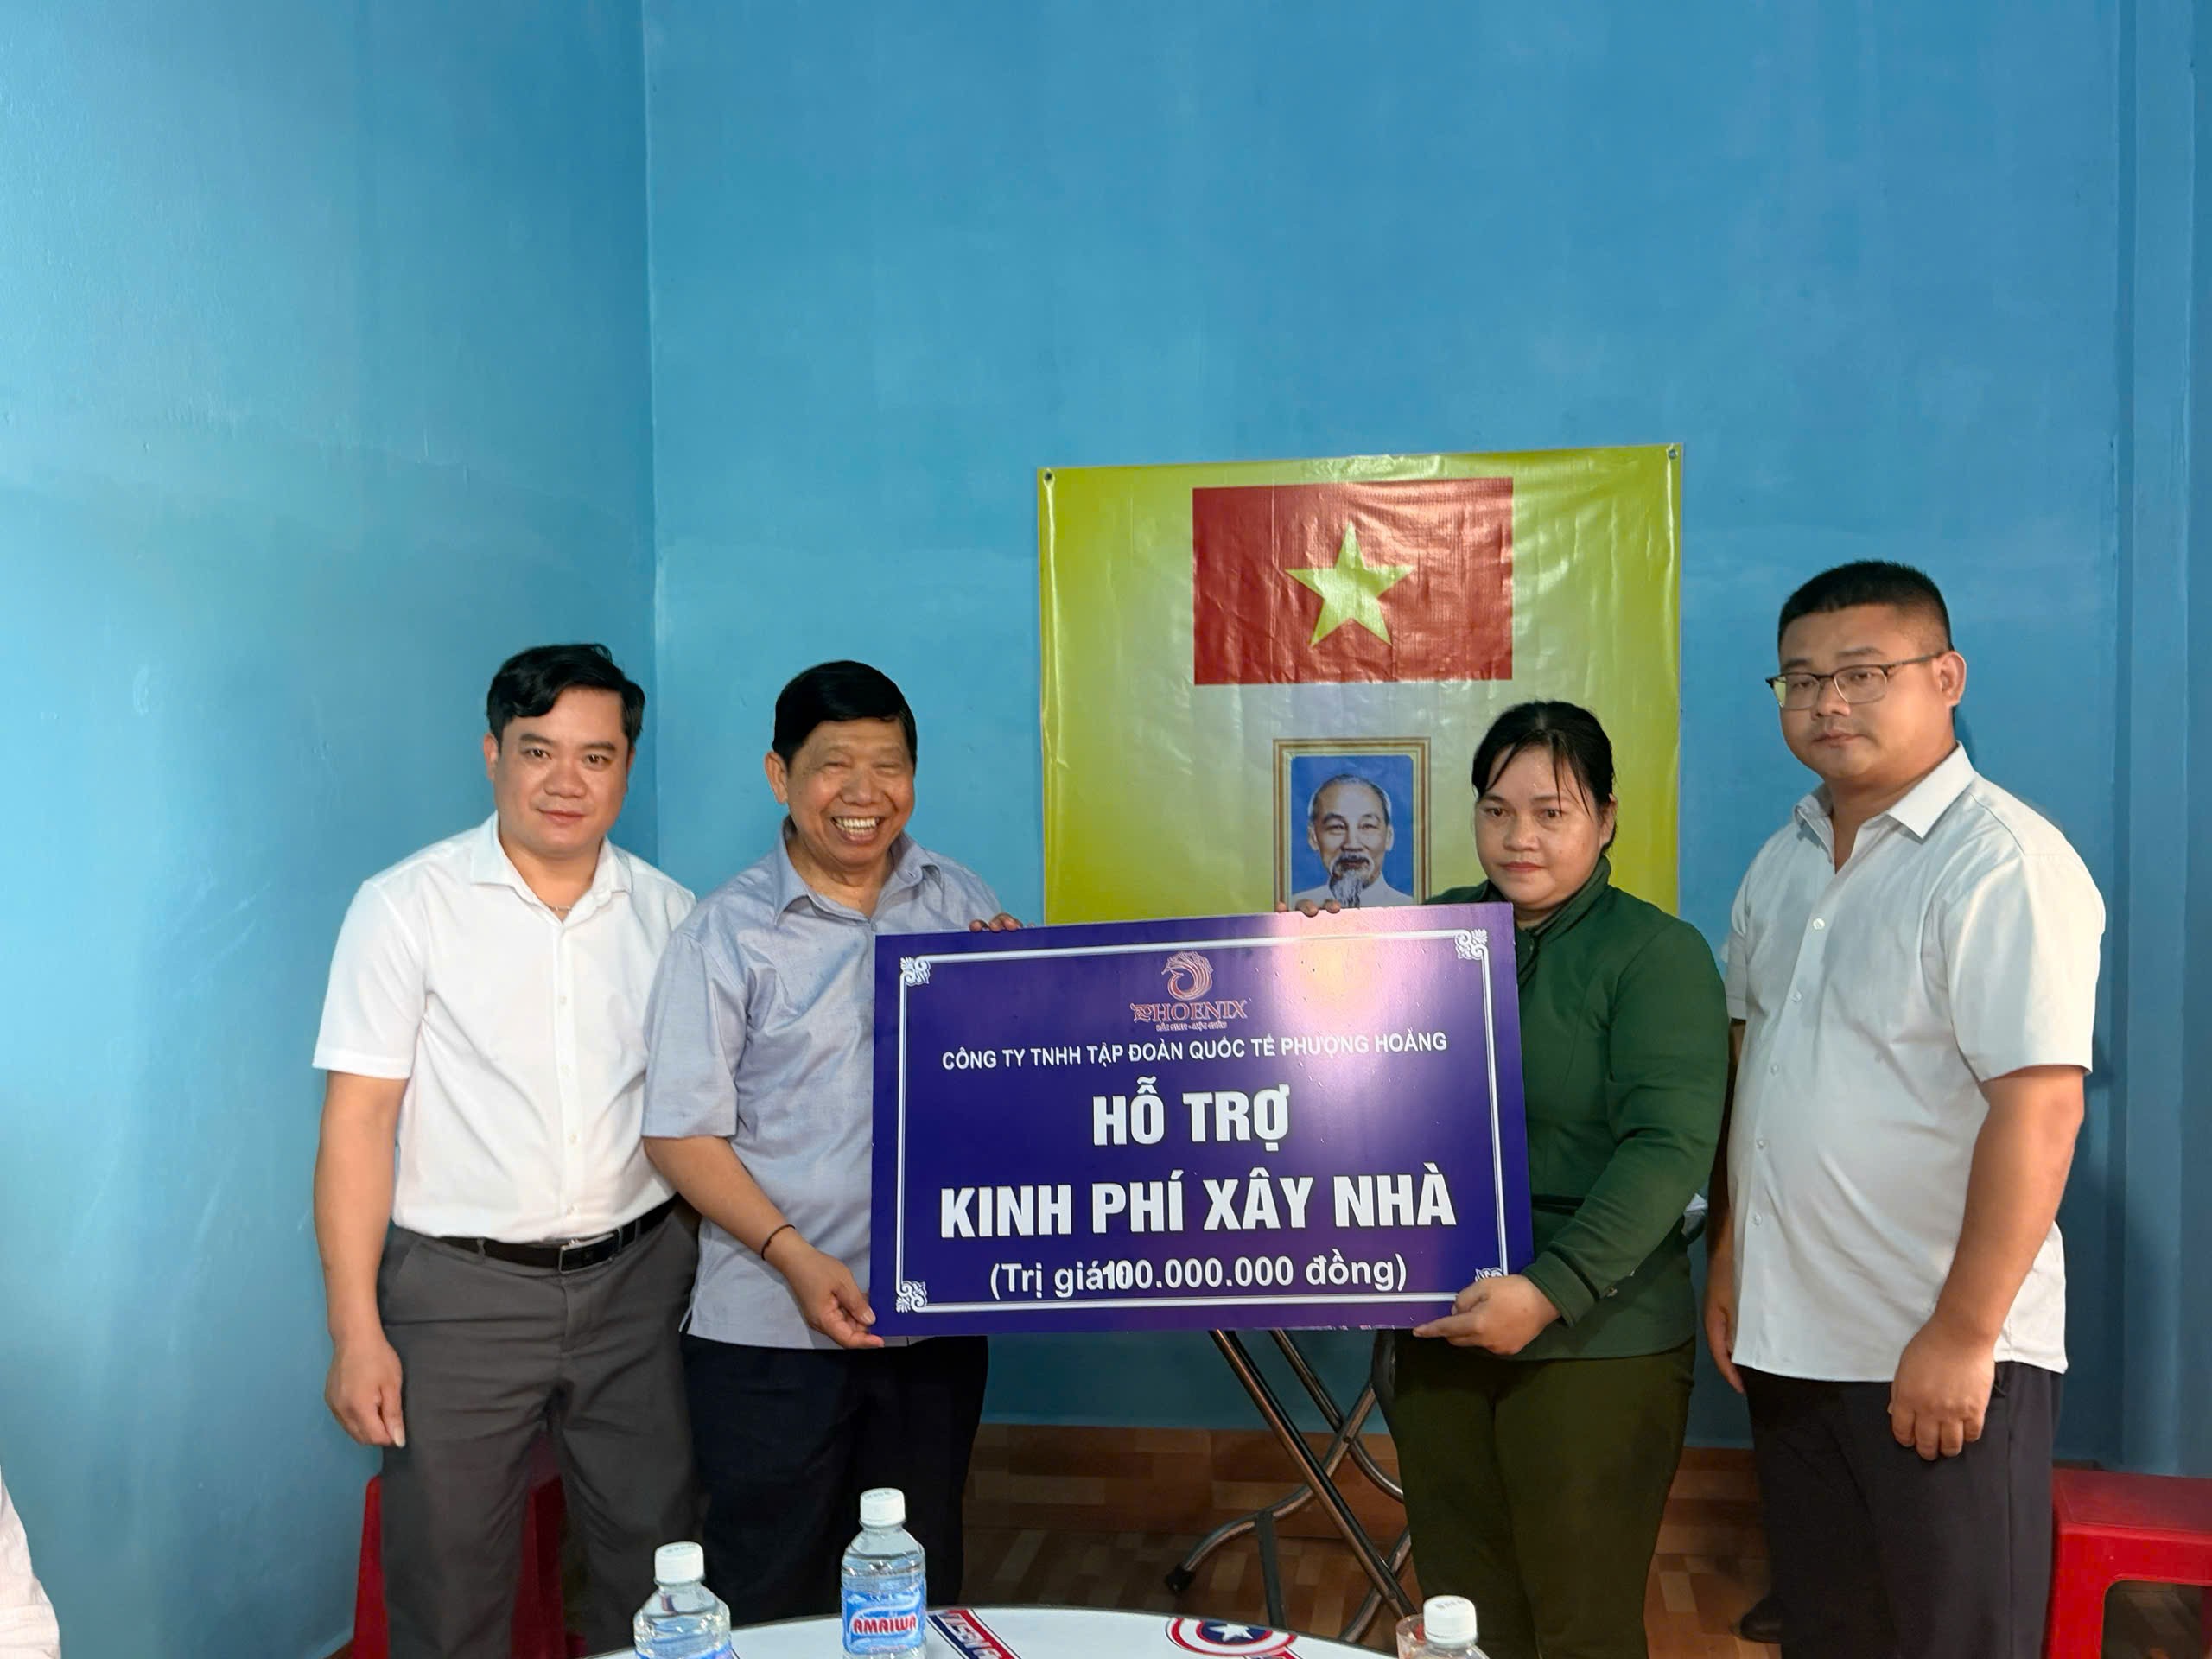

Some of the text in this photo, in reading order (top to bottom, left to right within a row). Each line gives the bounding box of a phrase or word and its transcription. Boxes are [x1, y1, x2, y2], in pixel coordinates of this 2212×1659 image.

[1130, 999, 1248, 1023] PHOENIX
[942, 1027, 1448, 1071] CÔNG TY TNHH TẬP ĐOÀN QUỐC TẾ PHƯỢNG HOÀNG
[1092, 1075, 1292, 1153] HỖ TRỢ
[940, 1161, 1458, 1239] KINH PHÍ XÂY NHÀ
[990, 1262, 1044, 1300] (Trị
[1305, 1248, 1408, 1292] đồng)
